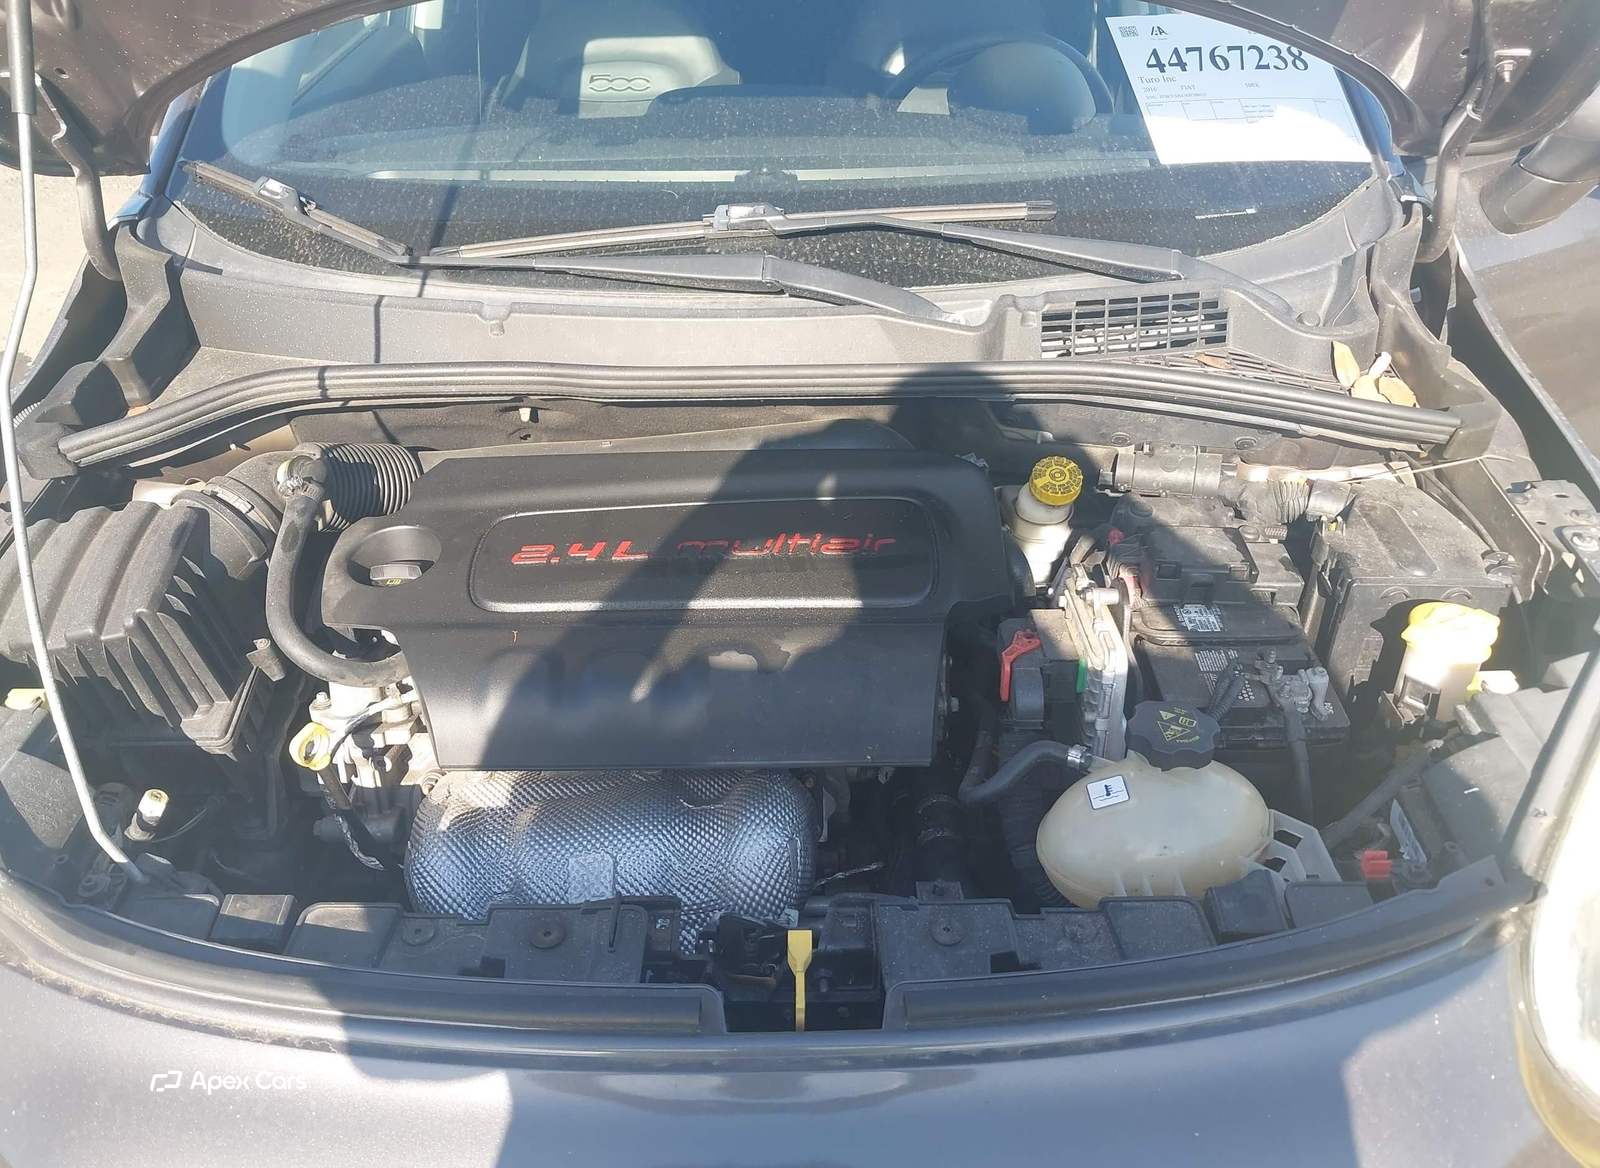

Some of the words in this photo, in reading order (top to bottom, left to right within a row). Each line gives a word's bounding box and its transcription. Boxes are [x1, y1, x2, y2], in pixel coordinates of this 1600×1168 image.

[1145, 45, 1309, 73] 44767238
[588, 74, 651, 93] 500
[1138, 76, 1161, 84] Turo
[1162, 75, 1178, 83] Inc
[676, 532, 897, 556] multiair
